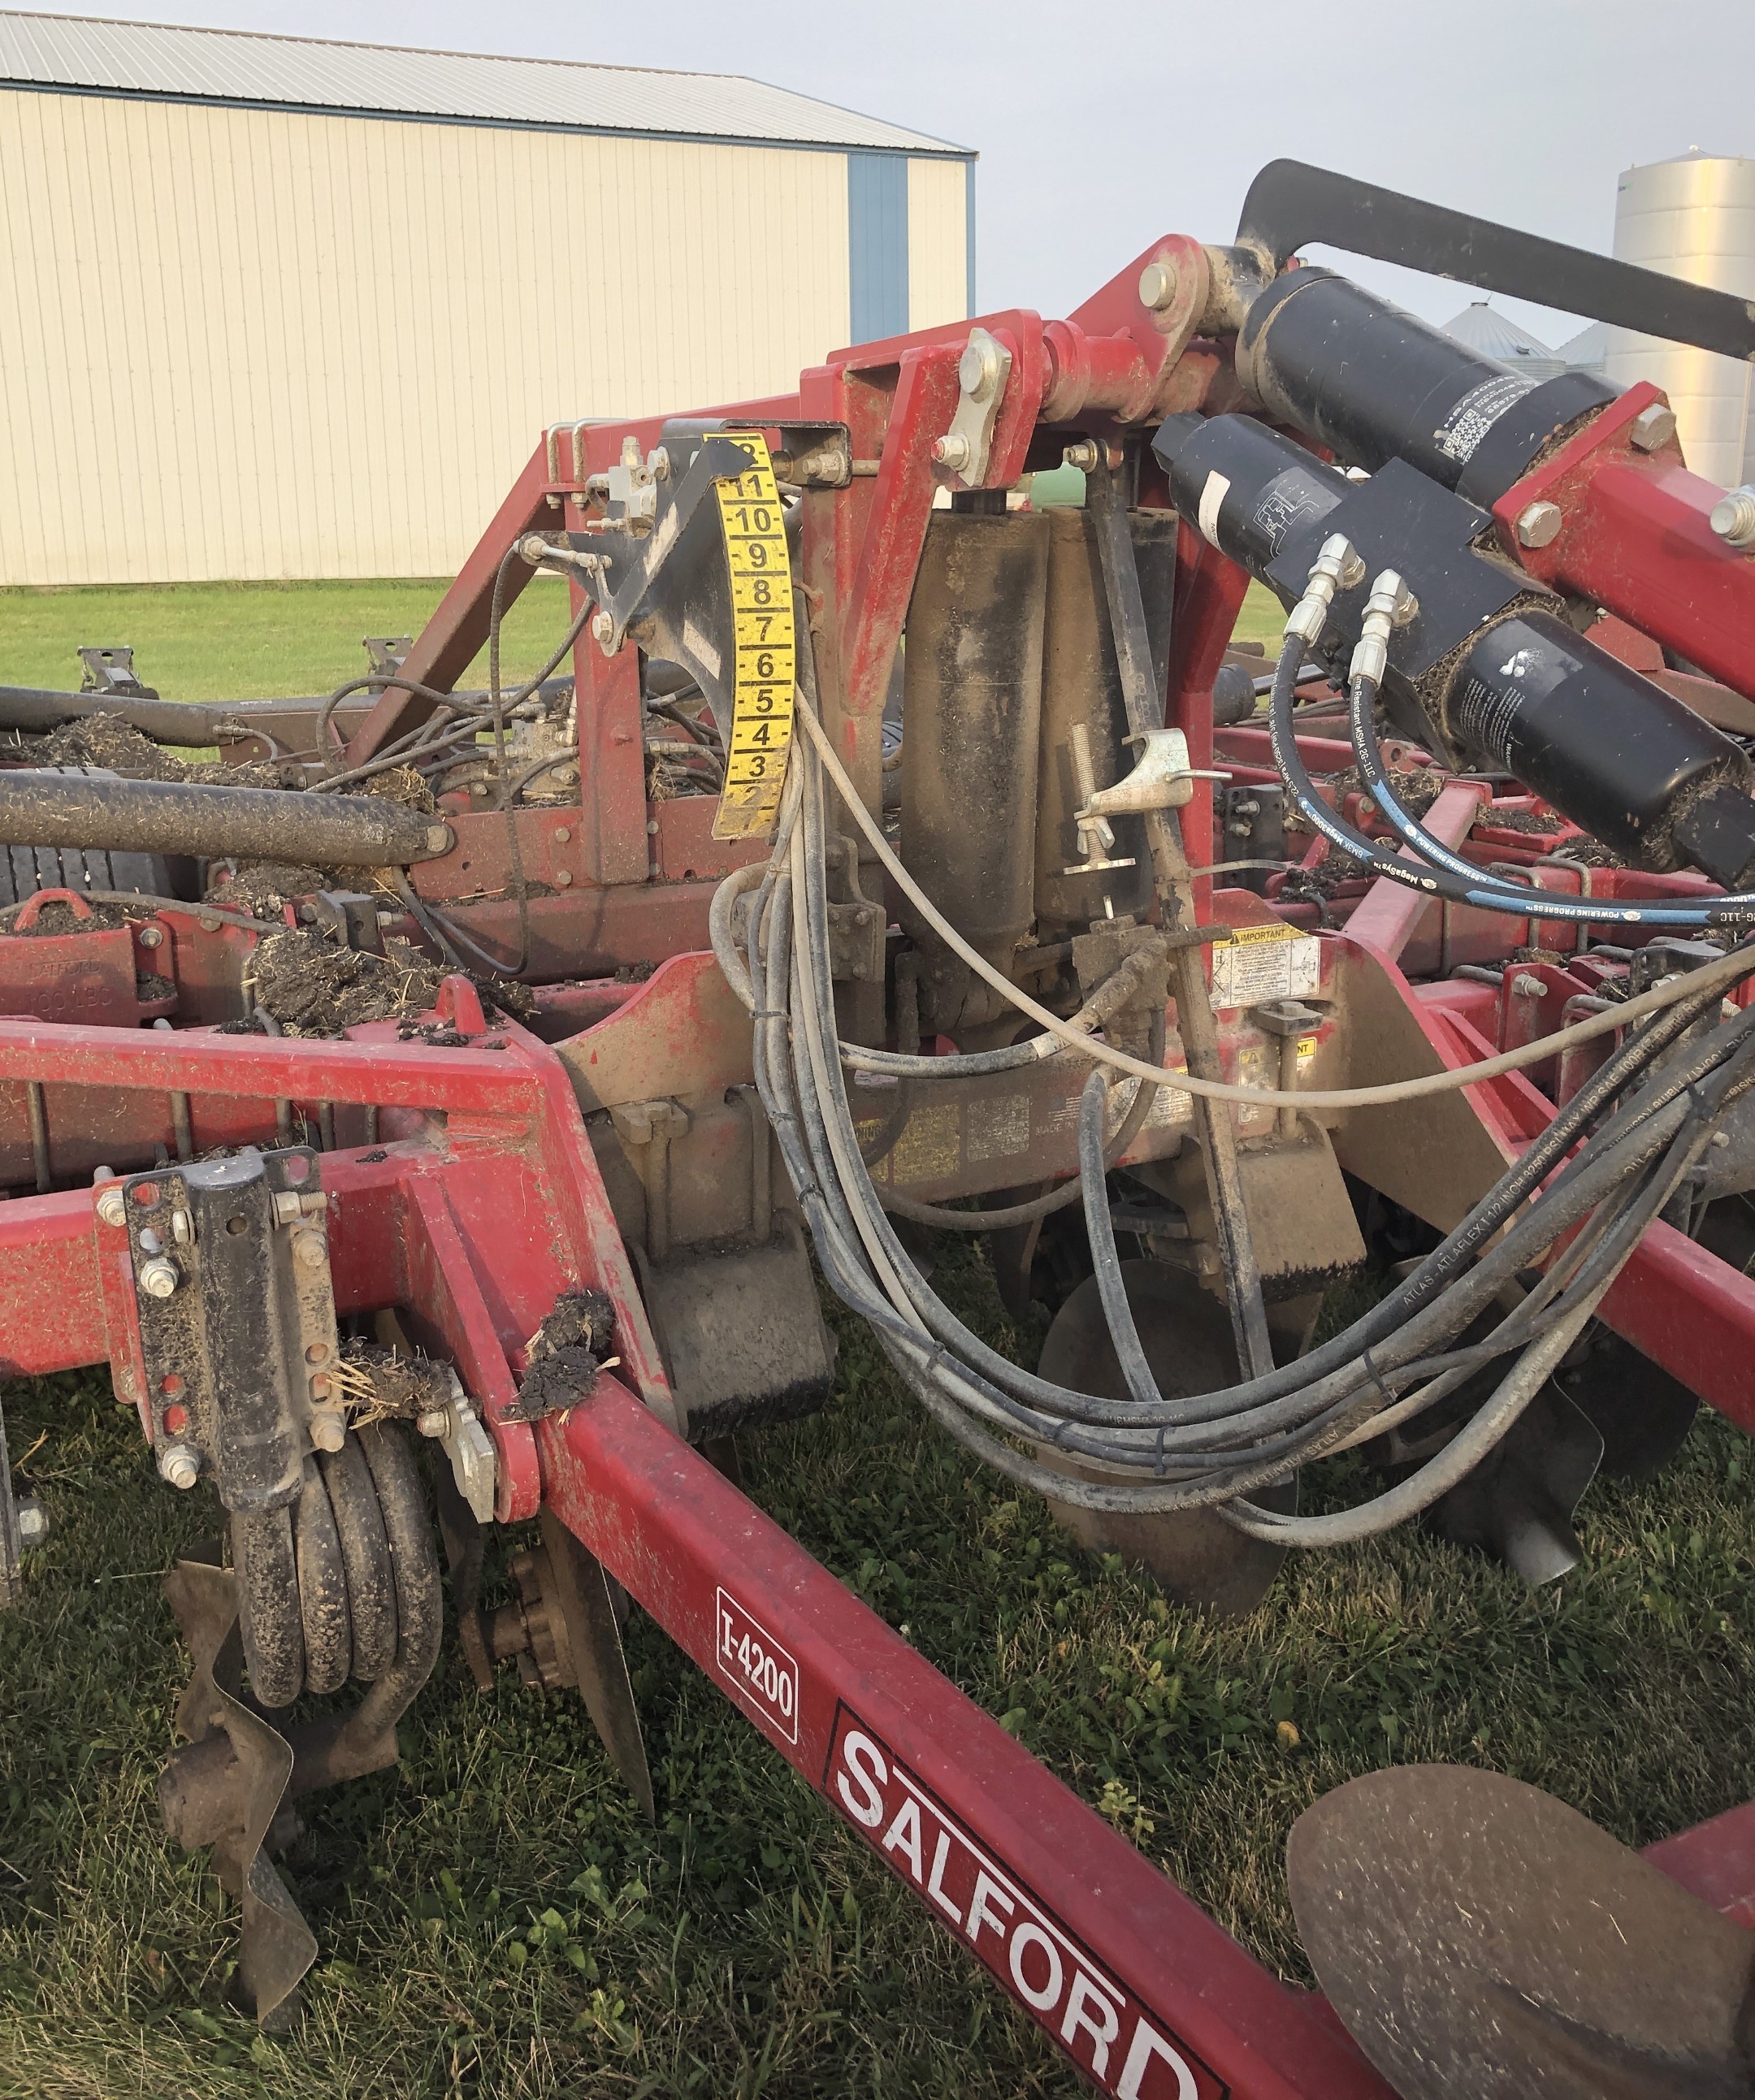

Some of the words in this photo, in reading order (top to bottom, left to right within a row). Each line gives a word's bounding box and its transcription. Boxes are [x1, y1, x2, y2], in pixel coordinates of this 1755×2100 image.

[729, 474, 762, 496] 11
[735, 508, 771, 532] 10
[748, 543, 767, 568] 9
[753, 579, 771, 604] 8
[756, 617, 774, 642] 7
[756, 652, 774, 678] 6
[756, 689, 774, 712] 5
[1353, 691, 1363, 726] Resistant
[752, 722, 770, 746] 4
[1355, 725, 1366, 749] MSHA
[748, 756, 765, 777] 3
[1280, 767, 1291, 782] MPa
[1359, 748, 1376, 777] 2G-11C
[741, 786, 761, 806] 2
[1287, 781, 1299, 798] 22.5
[1343, 840, 1363, 859] 6M3K
[1416, 836, 1448, 862] POWERING
[1576, 909, 1619, 919] POWERING
[1241, 929, 1285, 942] IMPORTANT
[1403, 1275, 1435, 1306] ATLAS
[1436, 1221, 1486, 1275] ATLAFLEX
[1487, 1202, 1502, 1219] 1/2
[1501, 1176, 1528, 1206] INCH
[1523, 1154, 1548, 1180] 3250
[1544, 1133, 1565, 1157] PSI
[1597, 1073, 1621, 1096] SAE
[1307, 1428, 1340, 1457] ATLAS
[722, 1609, 794, 1717] I-4200
[837, 1730, 1198, 2100] SALFORD
